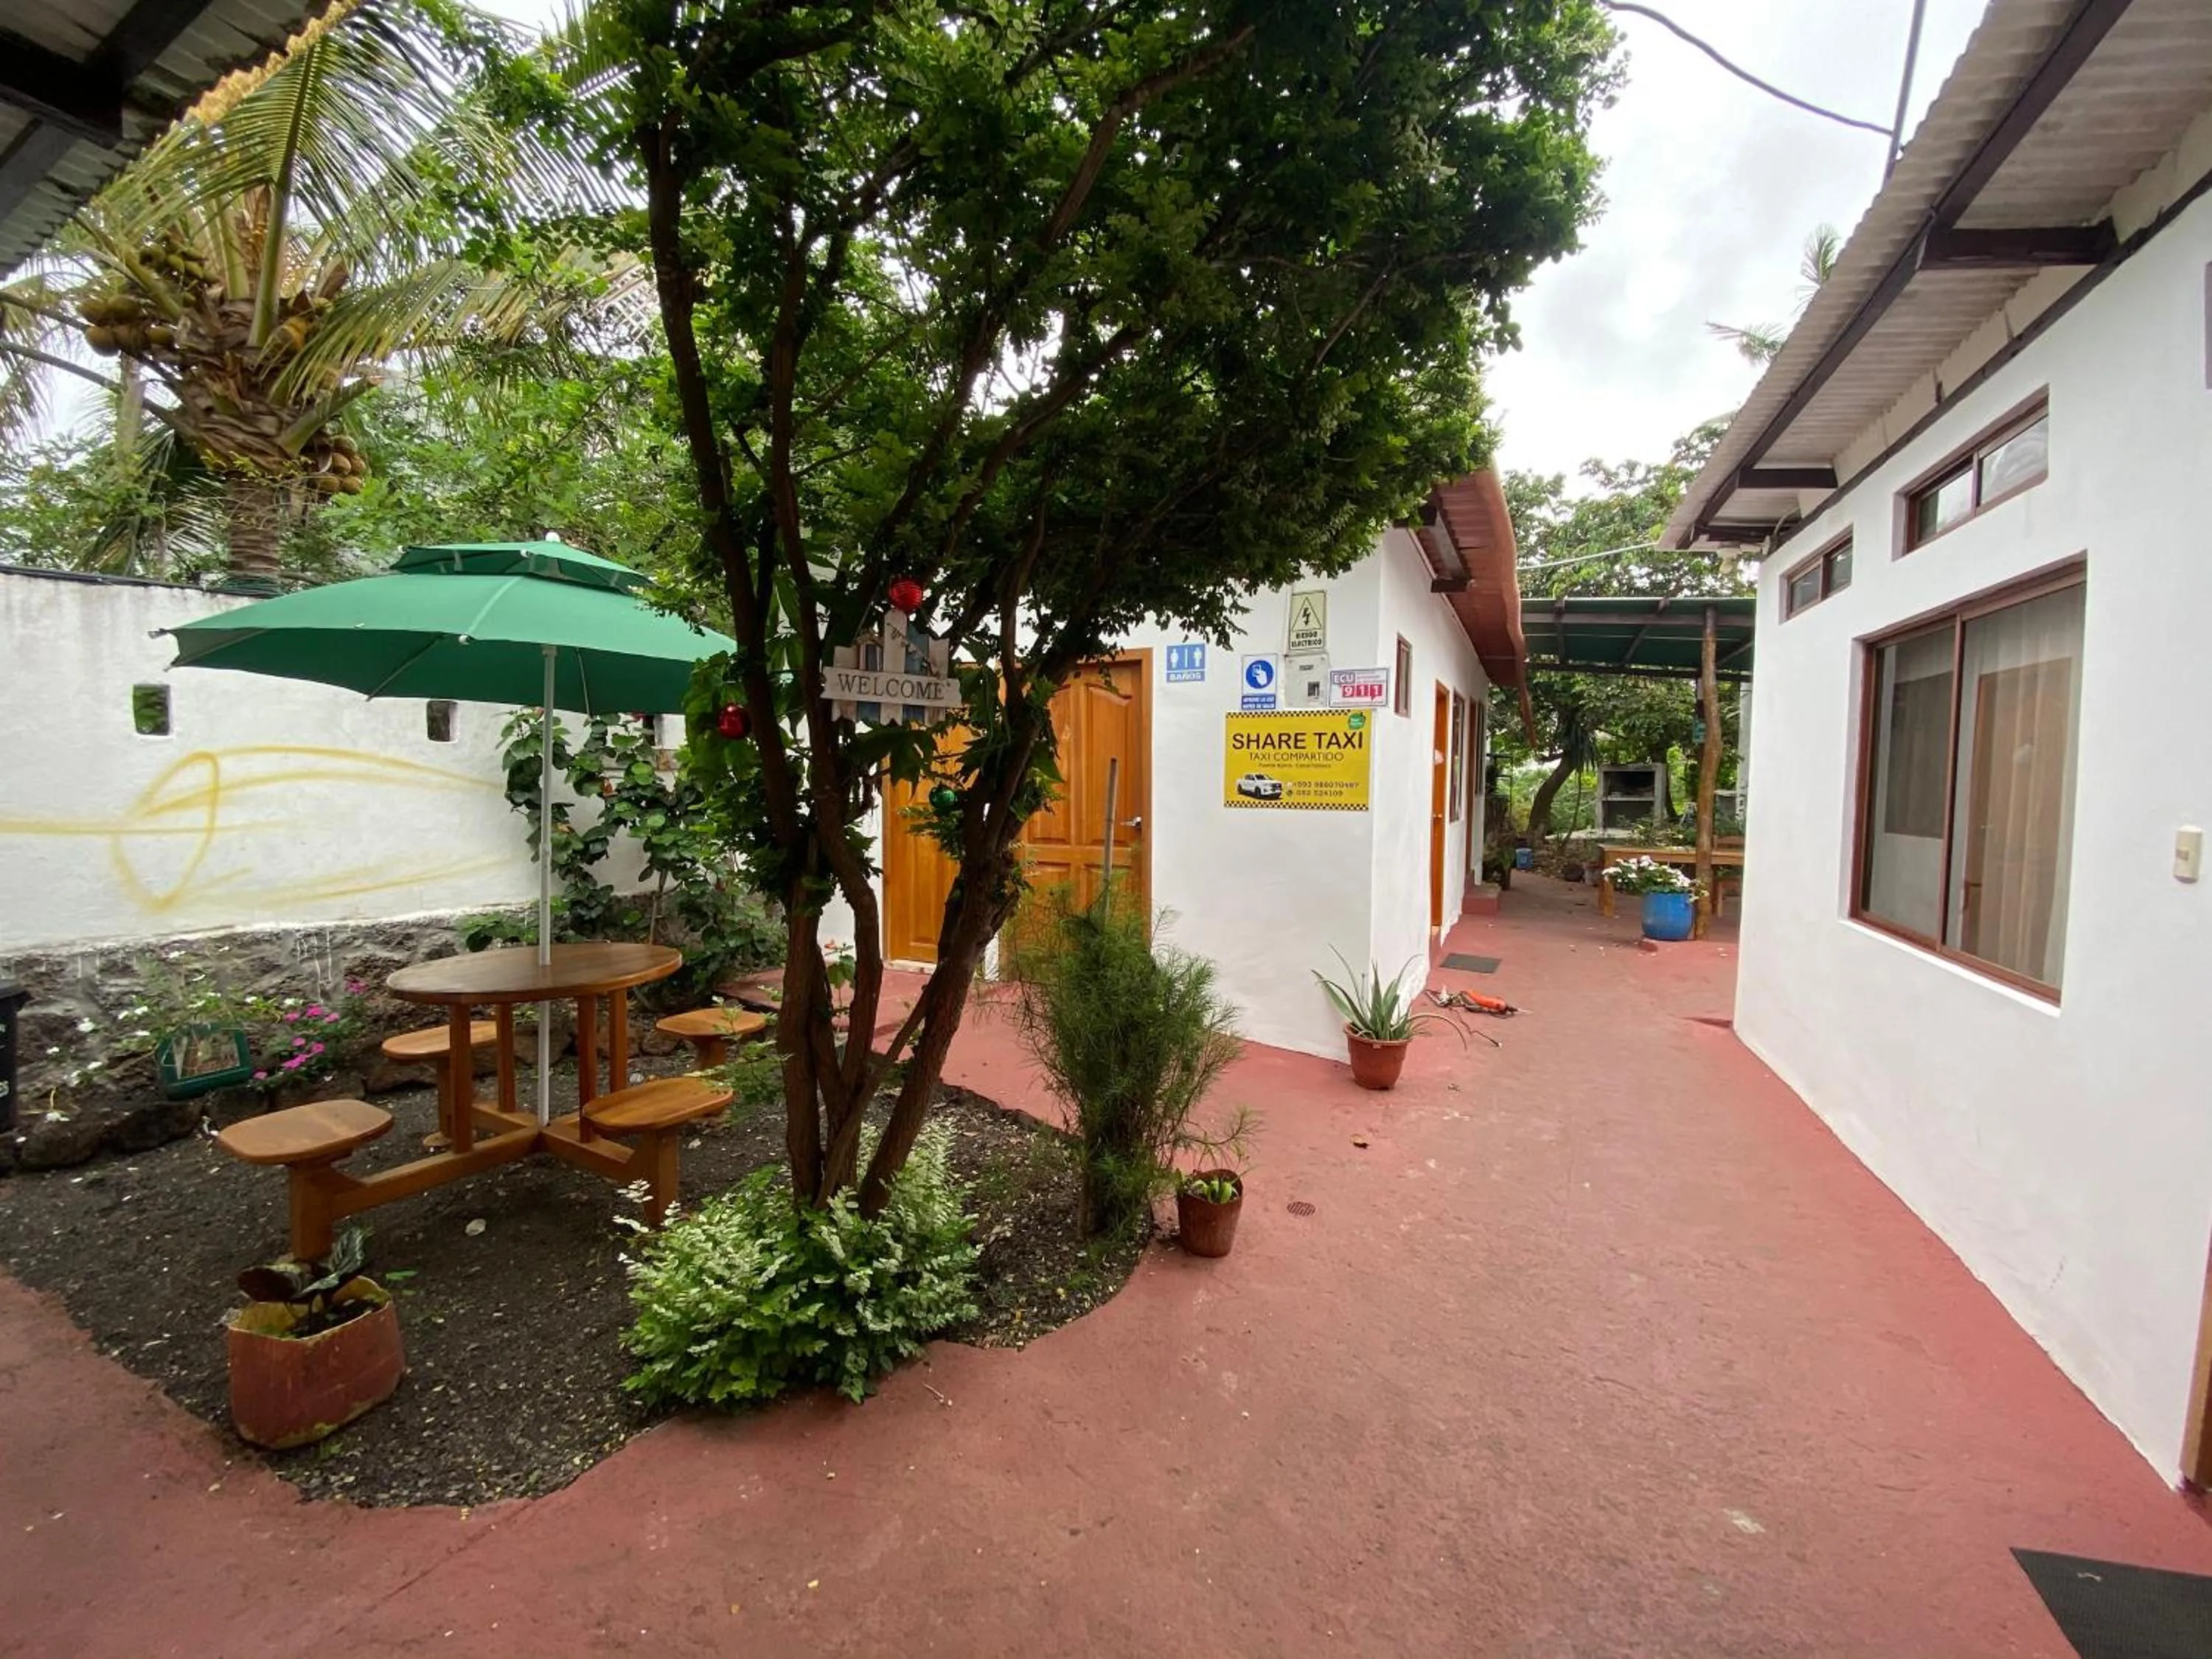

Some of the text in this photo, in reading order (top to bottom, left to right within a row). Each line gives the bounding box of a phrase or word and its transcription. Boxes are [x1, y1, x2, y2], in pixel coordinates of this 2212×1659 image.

[1333, 673, 1354, 684] ECU
[838, 673, 945, 700] WELCOME
[1344, 685, 1380, 696] 911
[1232, 731, 1363, 750] SHARE TAXI
[1249, 752, 1344, 762] TAXI COMPARTIDO
